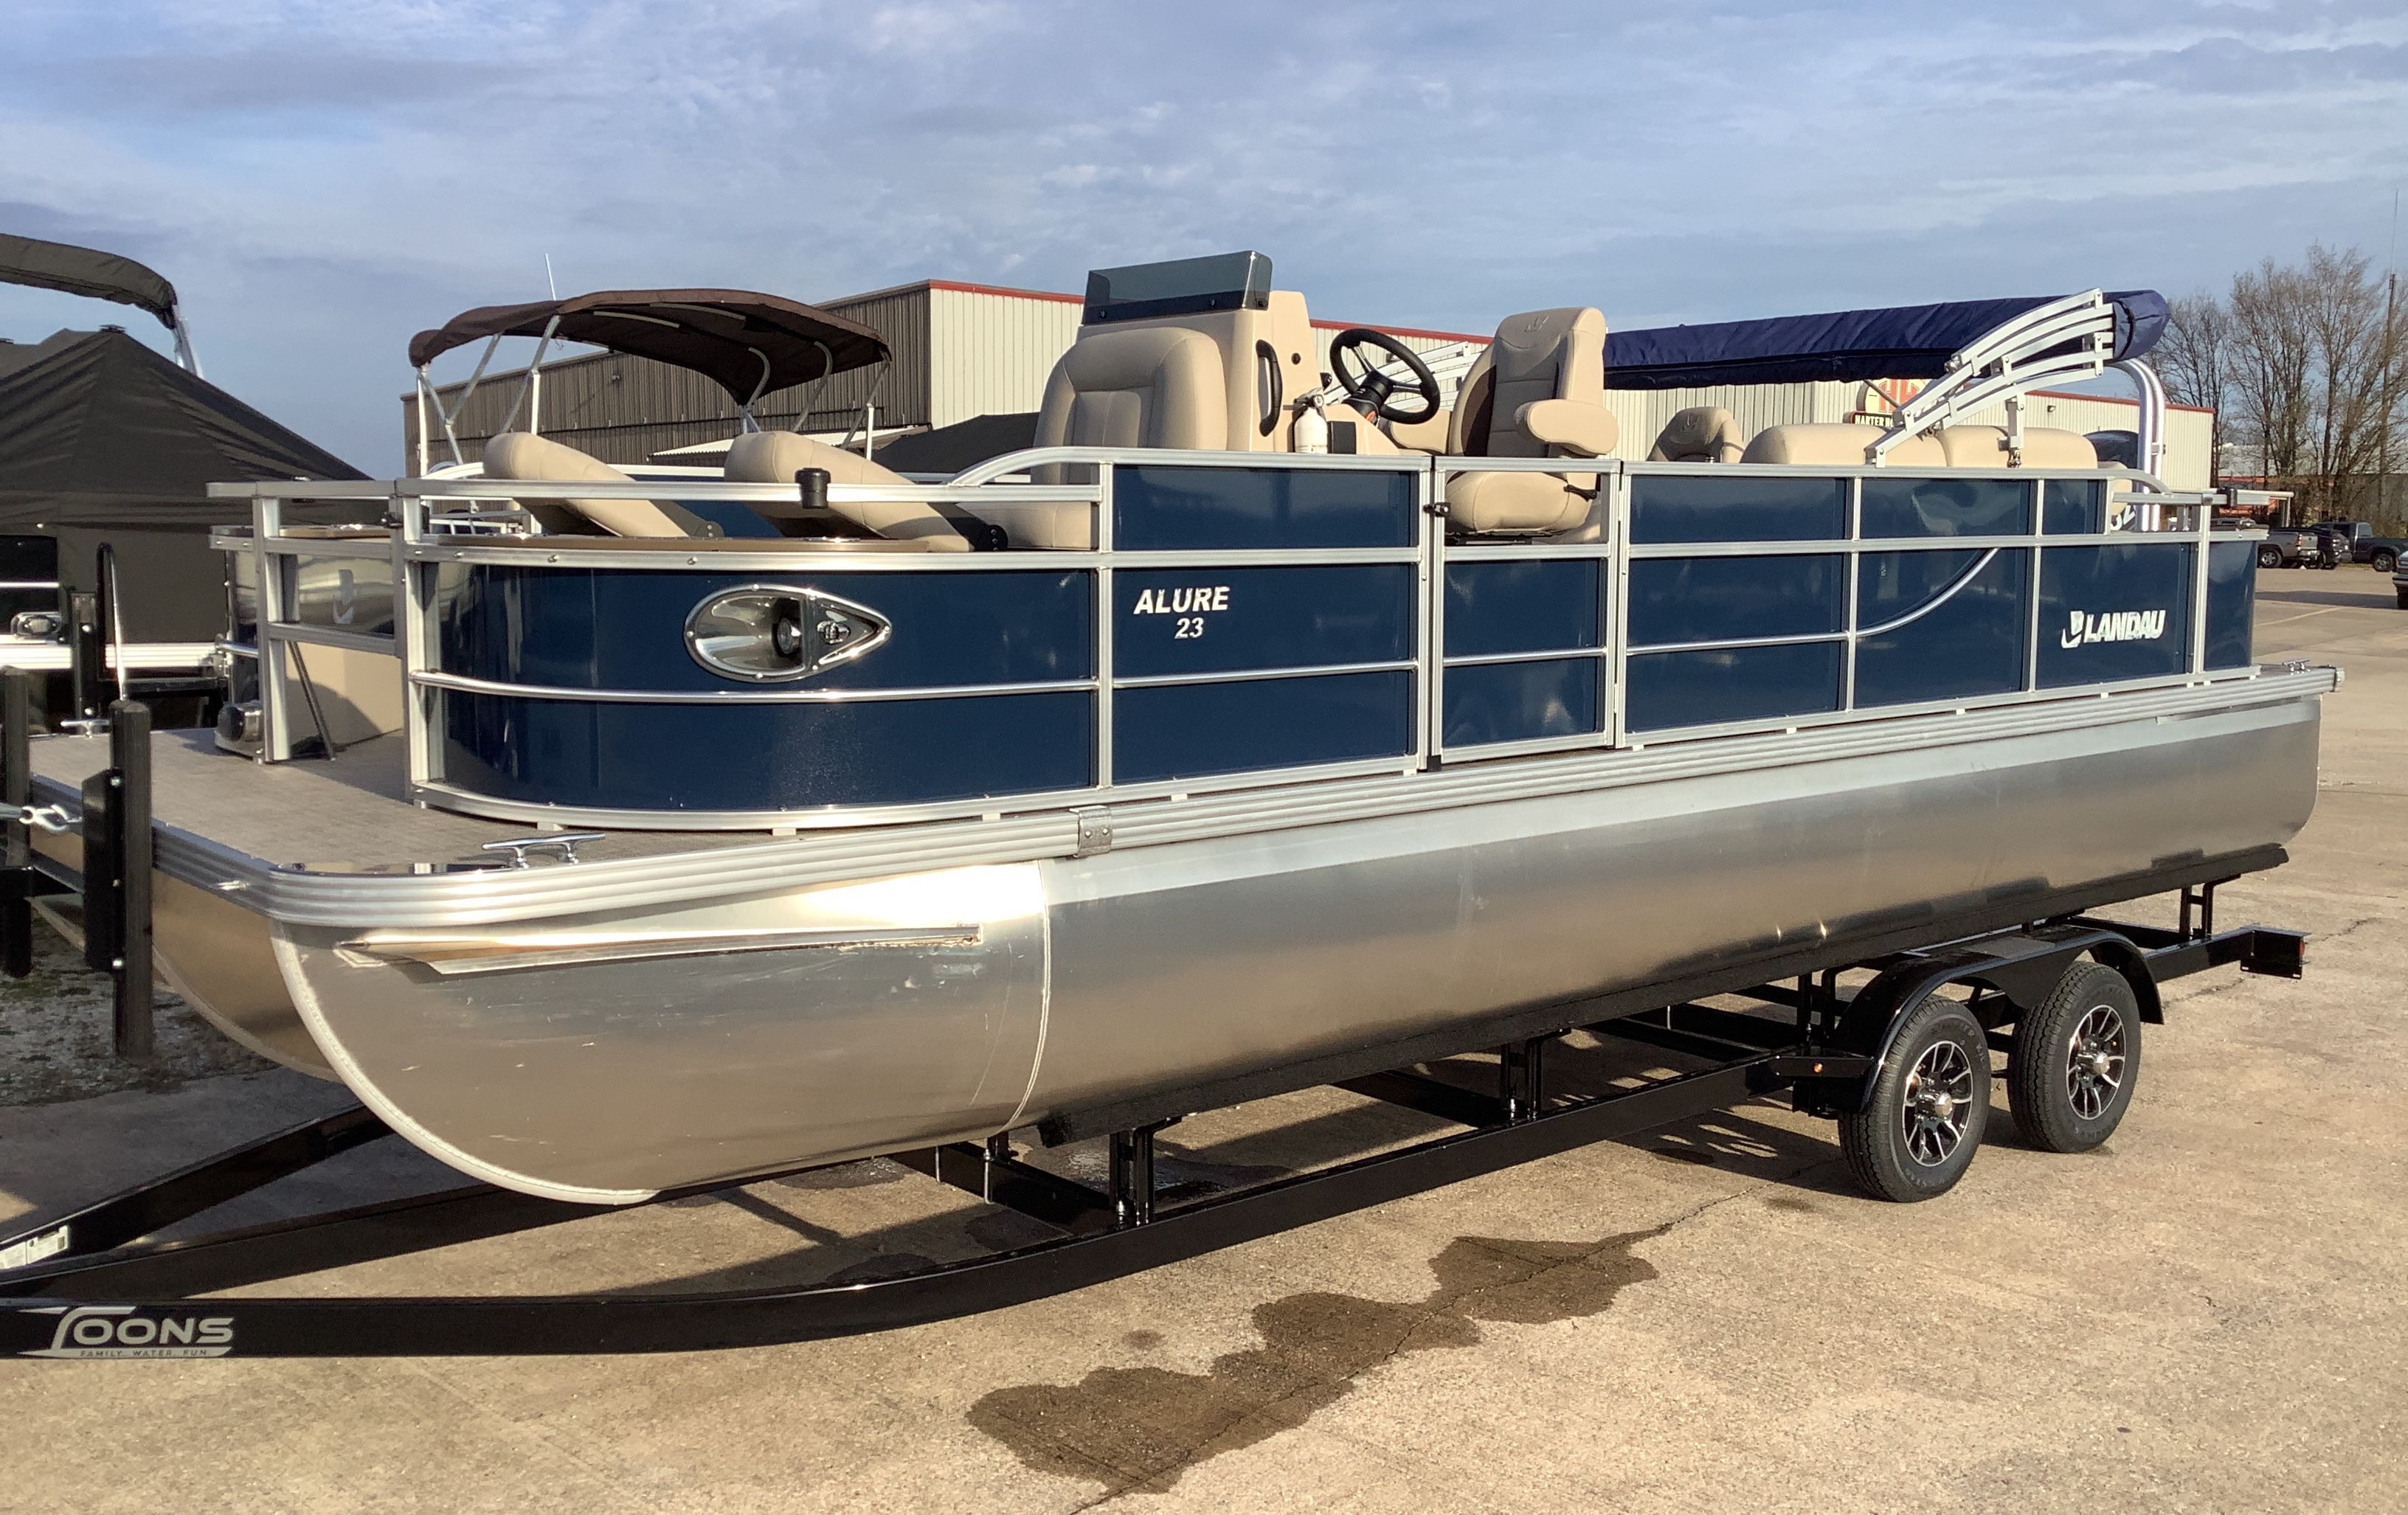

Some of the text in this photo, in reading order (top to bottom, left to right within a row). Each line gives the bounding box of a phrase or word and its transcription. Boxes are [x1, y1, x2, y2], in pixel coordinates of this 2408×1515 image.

[1133, 586, 1230, 614] ALURE
[1174, 617, 1204, 639] 23
[2083, 609, 2166, 643] LANDAU
